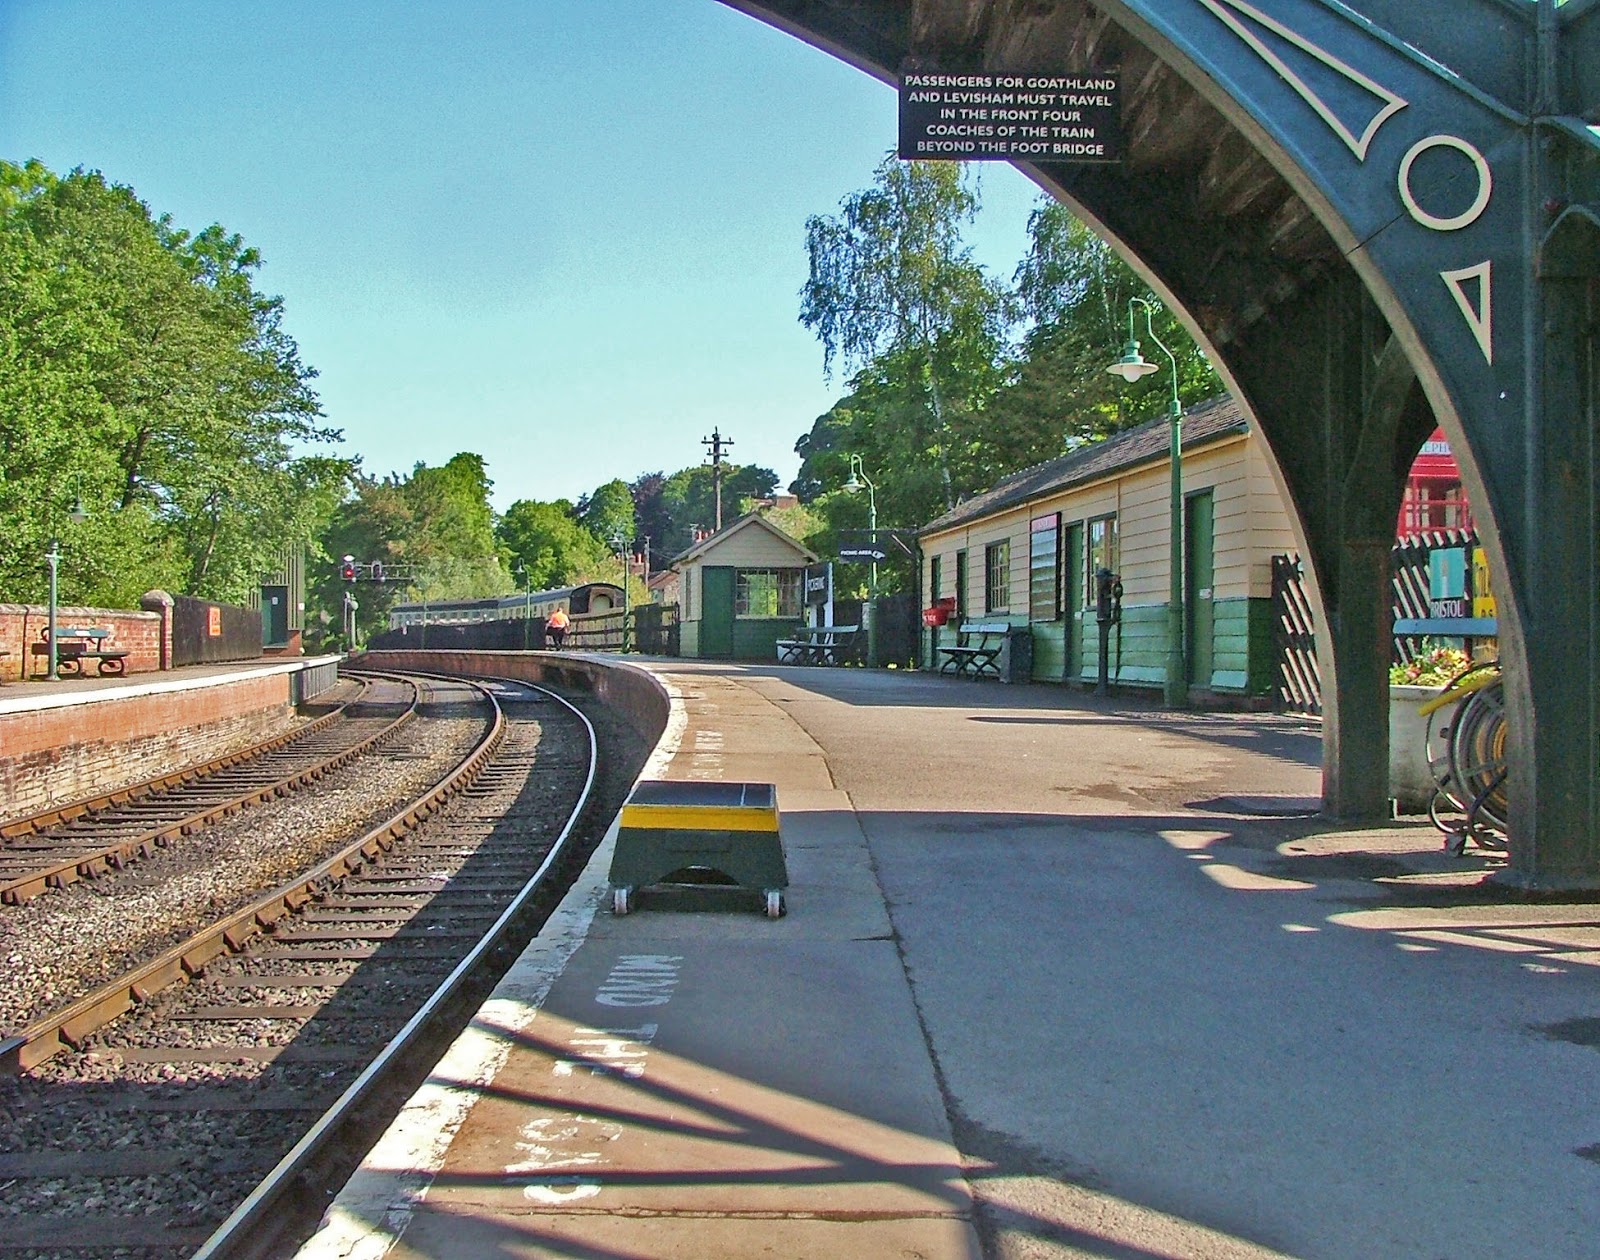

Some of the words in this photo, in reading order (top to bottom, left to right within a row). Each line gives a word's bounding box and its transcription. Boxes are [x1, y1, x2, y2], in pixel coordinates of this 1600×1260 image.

[905, 76, 992, 88] PASSENGERS
[996, 77, 1024, 88] FOR
[1026, 77, 1116, 90] GOATHLAND
[908, 92, 941, 103] AND
[944, 93, 1014, 104] LEVISHAM
[1017, 94, 1055, 105] MUST
[1060, 95, 1112, 107] TRAVEL
[940, 109, 955, 119] IN
[959, 109, 987, 120] THE
[991, 110, 1039, 121] FRONT
[1042, 111, 1081, 122] FOUR
[926, 125, 993, 137] COACHES
[997, 126, 1016, 137] OF
[1019, 127, 1048, 138] THE
[1051, 127, 1095, 139] TRAIN
[917, 141, 975, 152] BEYOND
[978, 142, 1007, 153] THE
[1011, 143, 1049, 154] FOOT
[1053, 143, 1104, 155] BRIDGE
[1430, 600, 1463, 618] BRISTOL
[595, 955, 684, 1007] MIND
[552, 1023, 658, 1078] THE
